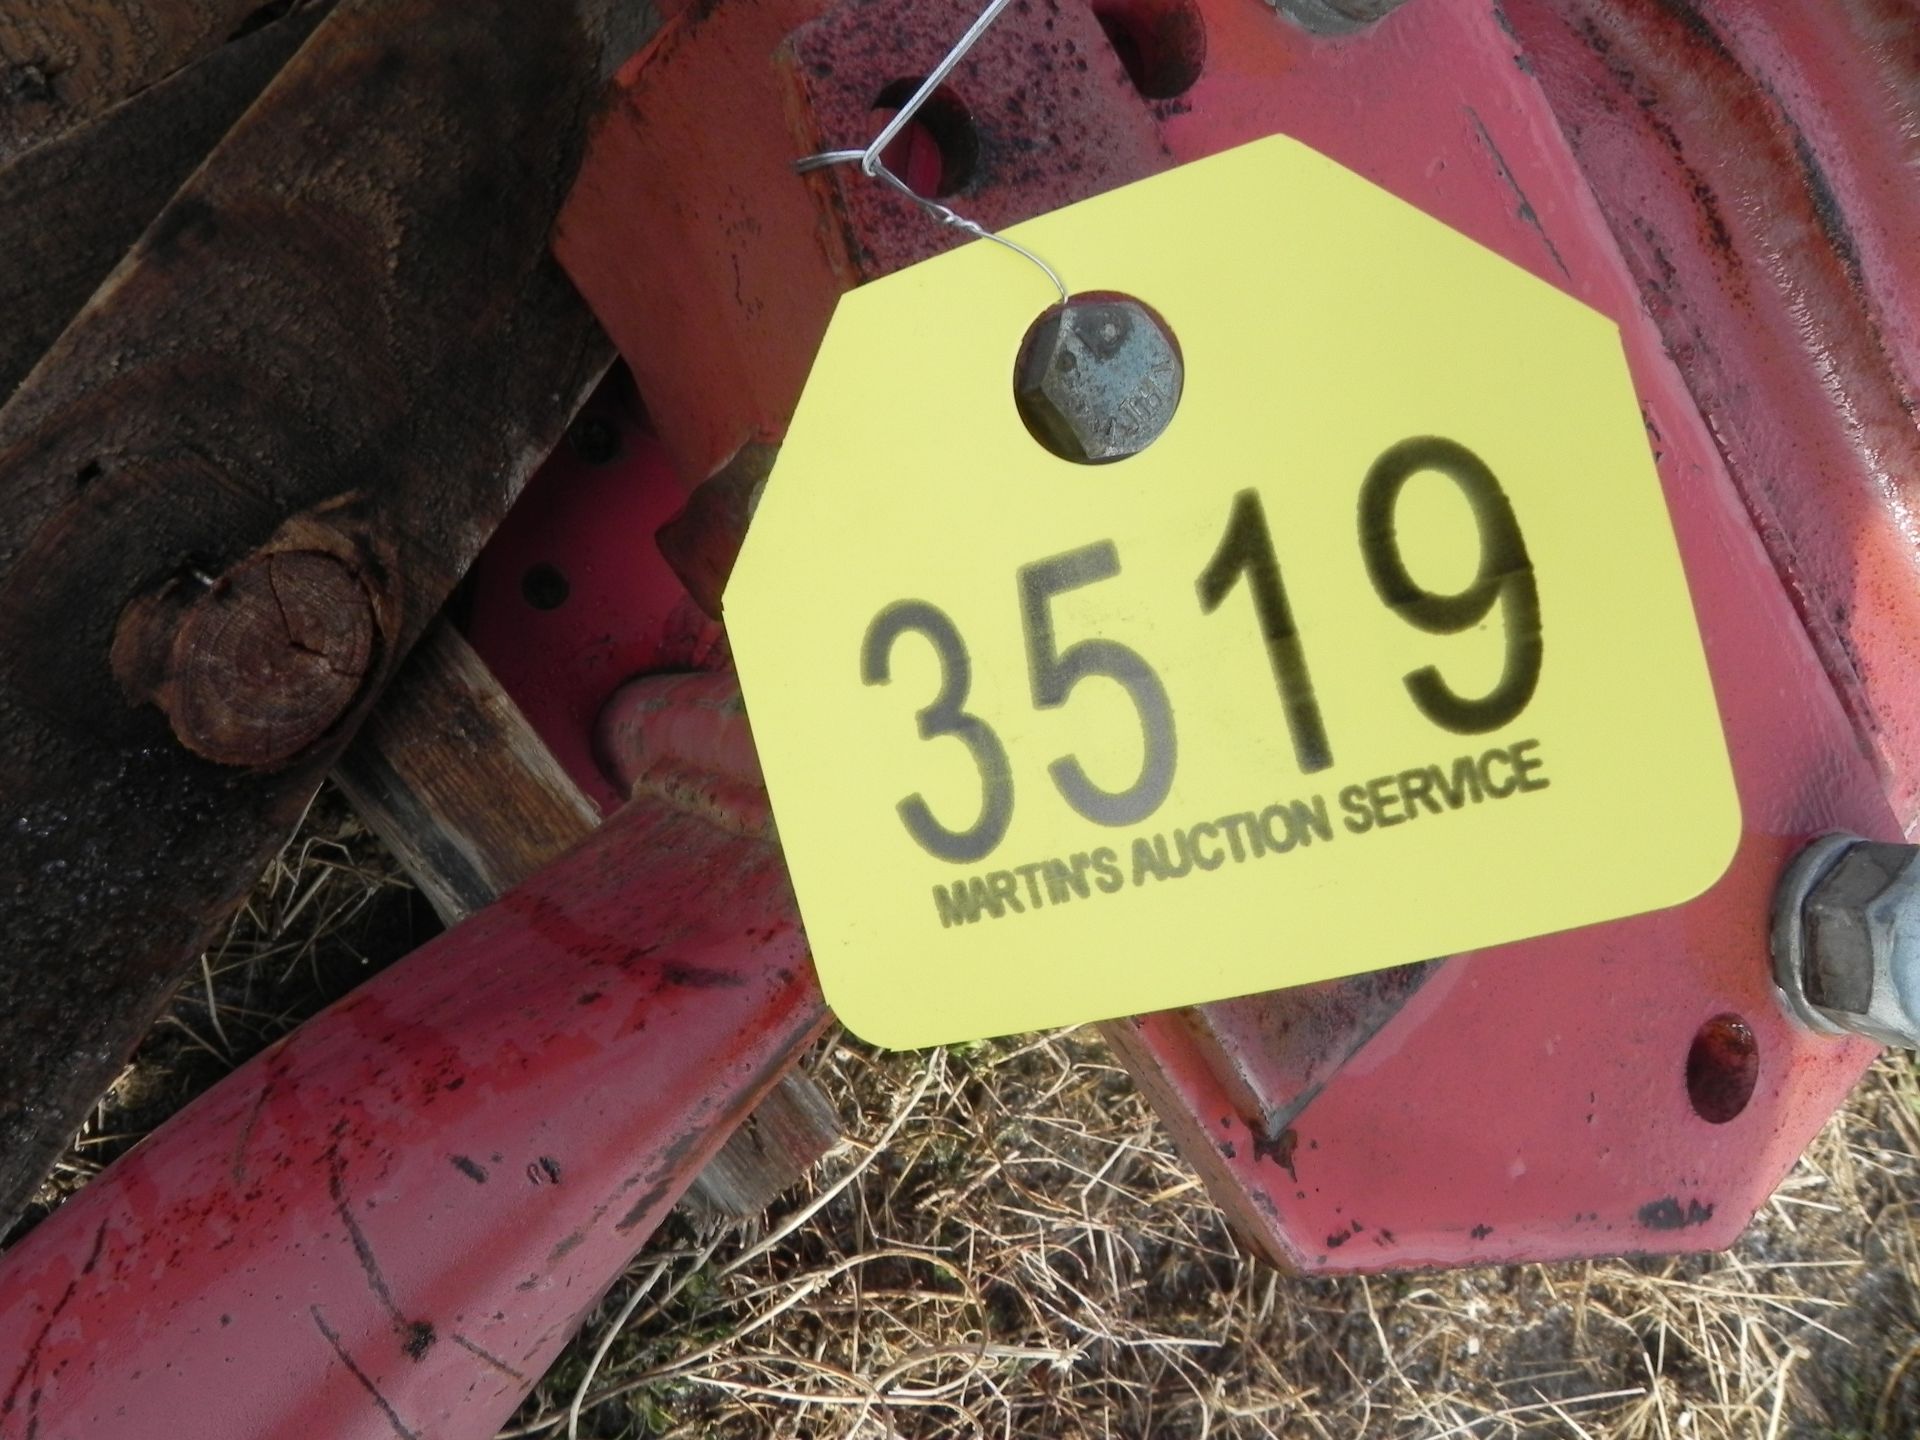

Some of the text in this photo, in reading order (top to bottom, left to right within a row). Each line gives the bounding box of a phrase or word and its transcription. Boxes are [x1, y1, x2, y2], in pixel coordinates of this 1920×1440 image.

[861, 434, 1544, 865] 3519
[932, 738, 1551, 929] MARTIN'S AUCTION SERVICE
